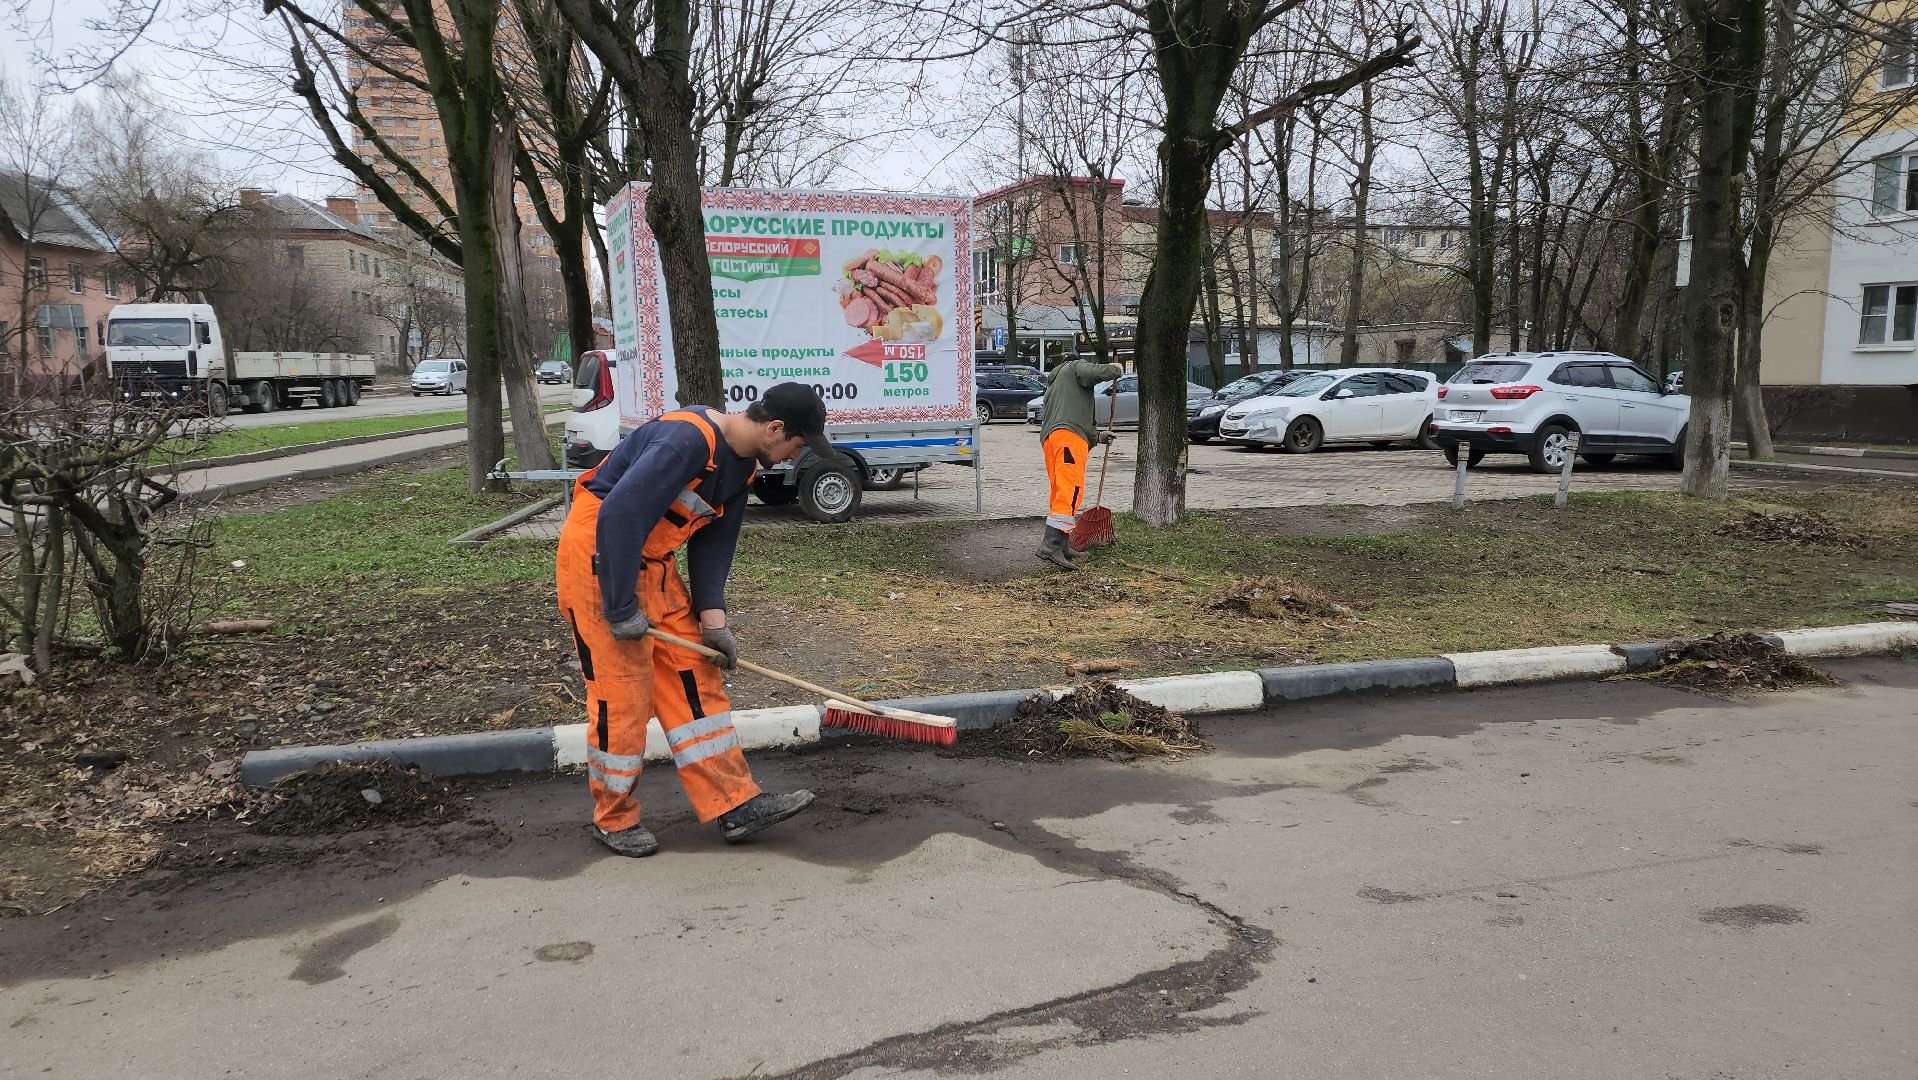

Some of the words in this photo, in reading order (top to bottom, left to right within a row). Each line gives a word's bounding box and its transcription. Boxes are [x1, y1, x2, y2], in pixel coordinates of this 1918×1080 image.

[832, 219, 944, 239] ПРОДУКТЫ
[762, 348, 835, 360] продукты
[757, 367, 831, 379] сгущенка
[884, 362, 929, 383] 150
[883, 388, 930, 399] метров
